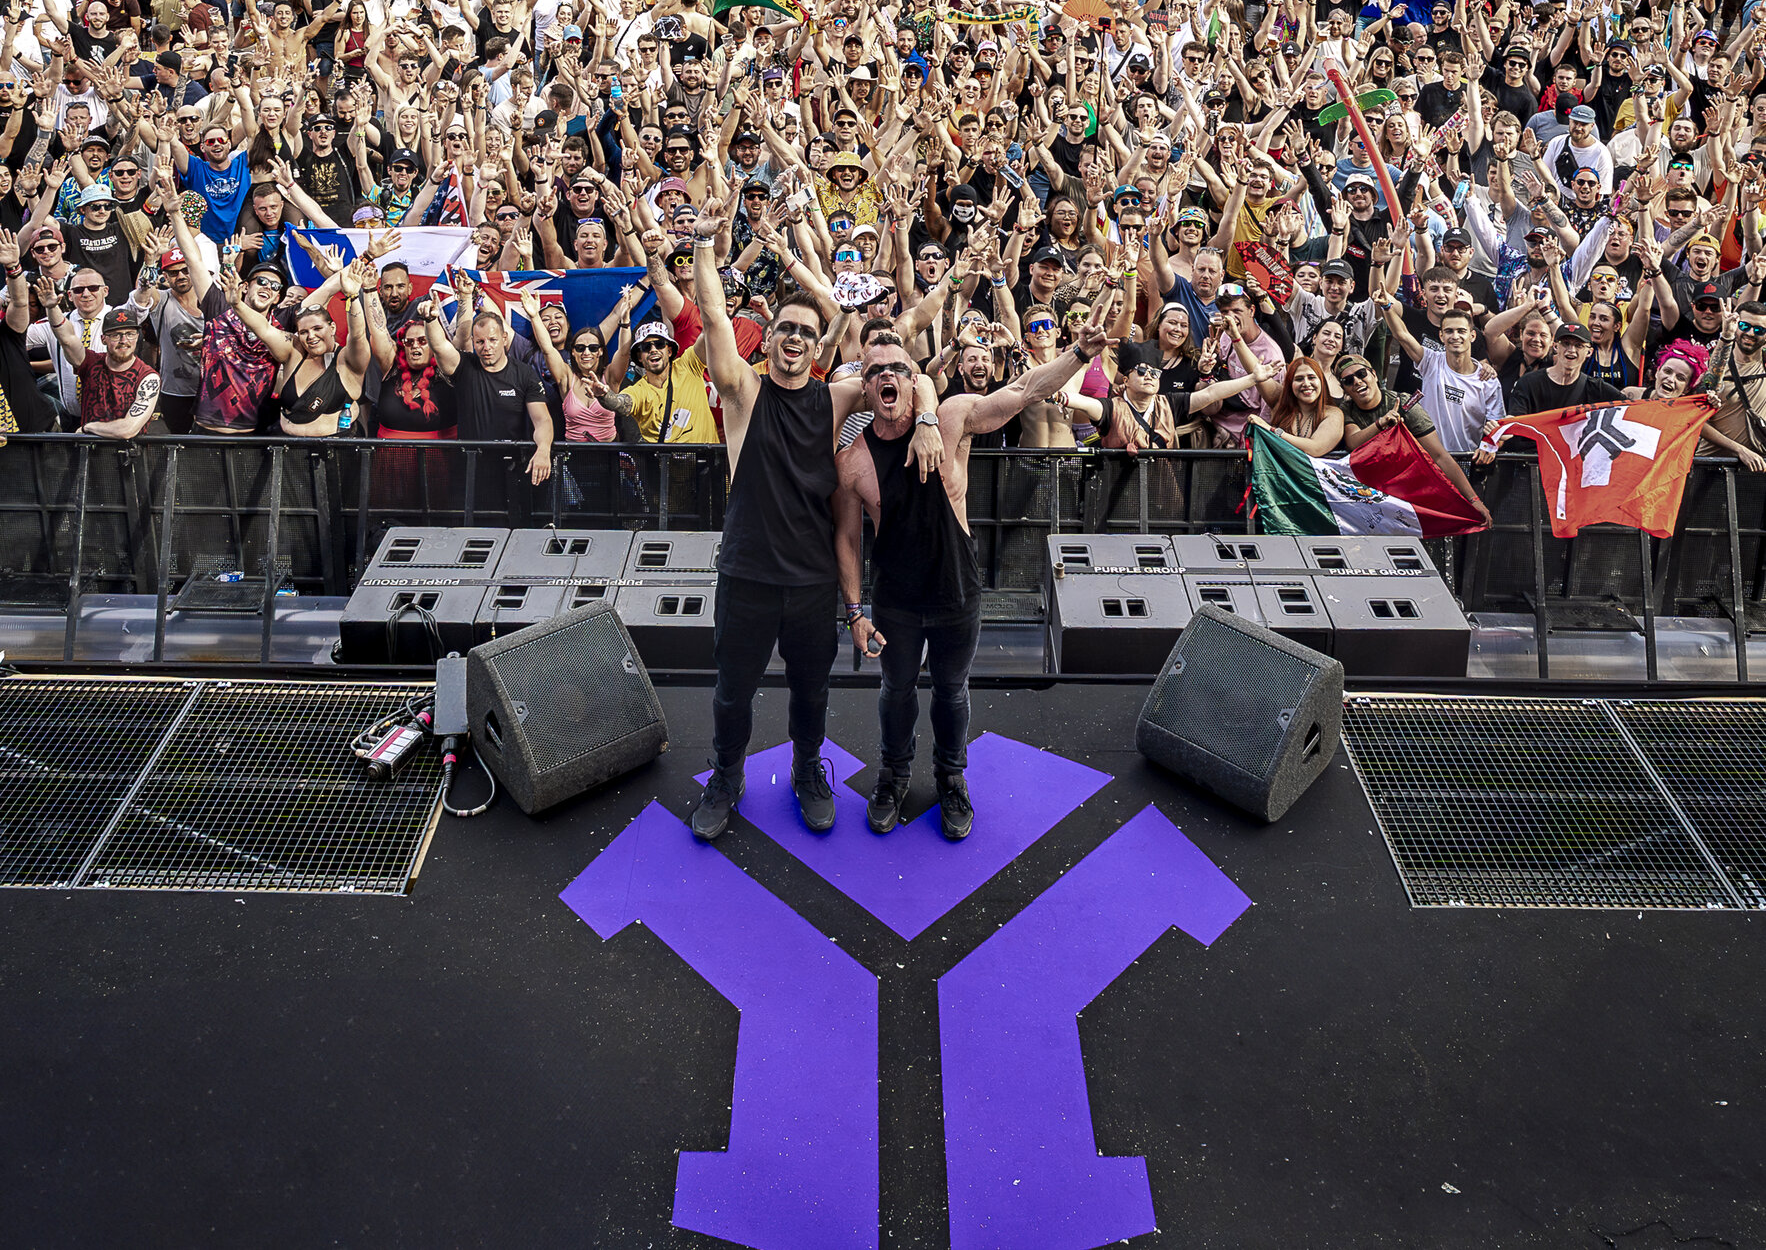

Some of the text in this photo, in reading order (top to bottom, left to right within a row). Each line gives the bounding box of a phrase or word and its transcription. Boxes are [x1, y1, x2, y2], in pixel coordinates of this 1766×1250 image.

[1144, 566, 1186, 574] GROUP
[1329, 568, 1377, 576] PURPLE
[364, 578, 460, 586] PURPLE GROUP
[547, 578, 643, 586] PURPLE GROUP
